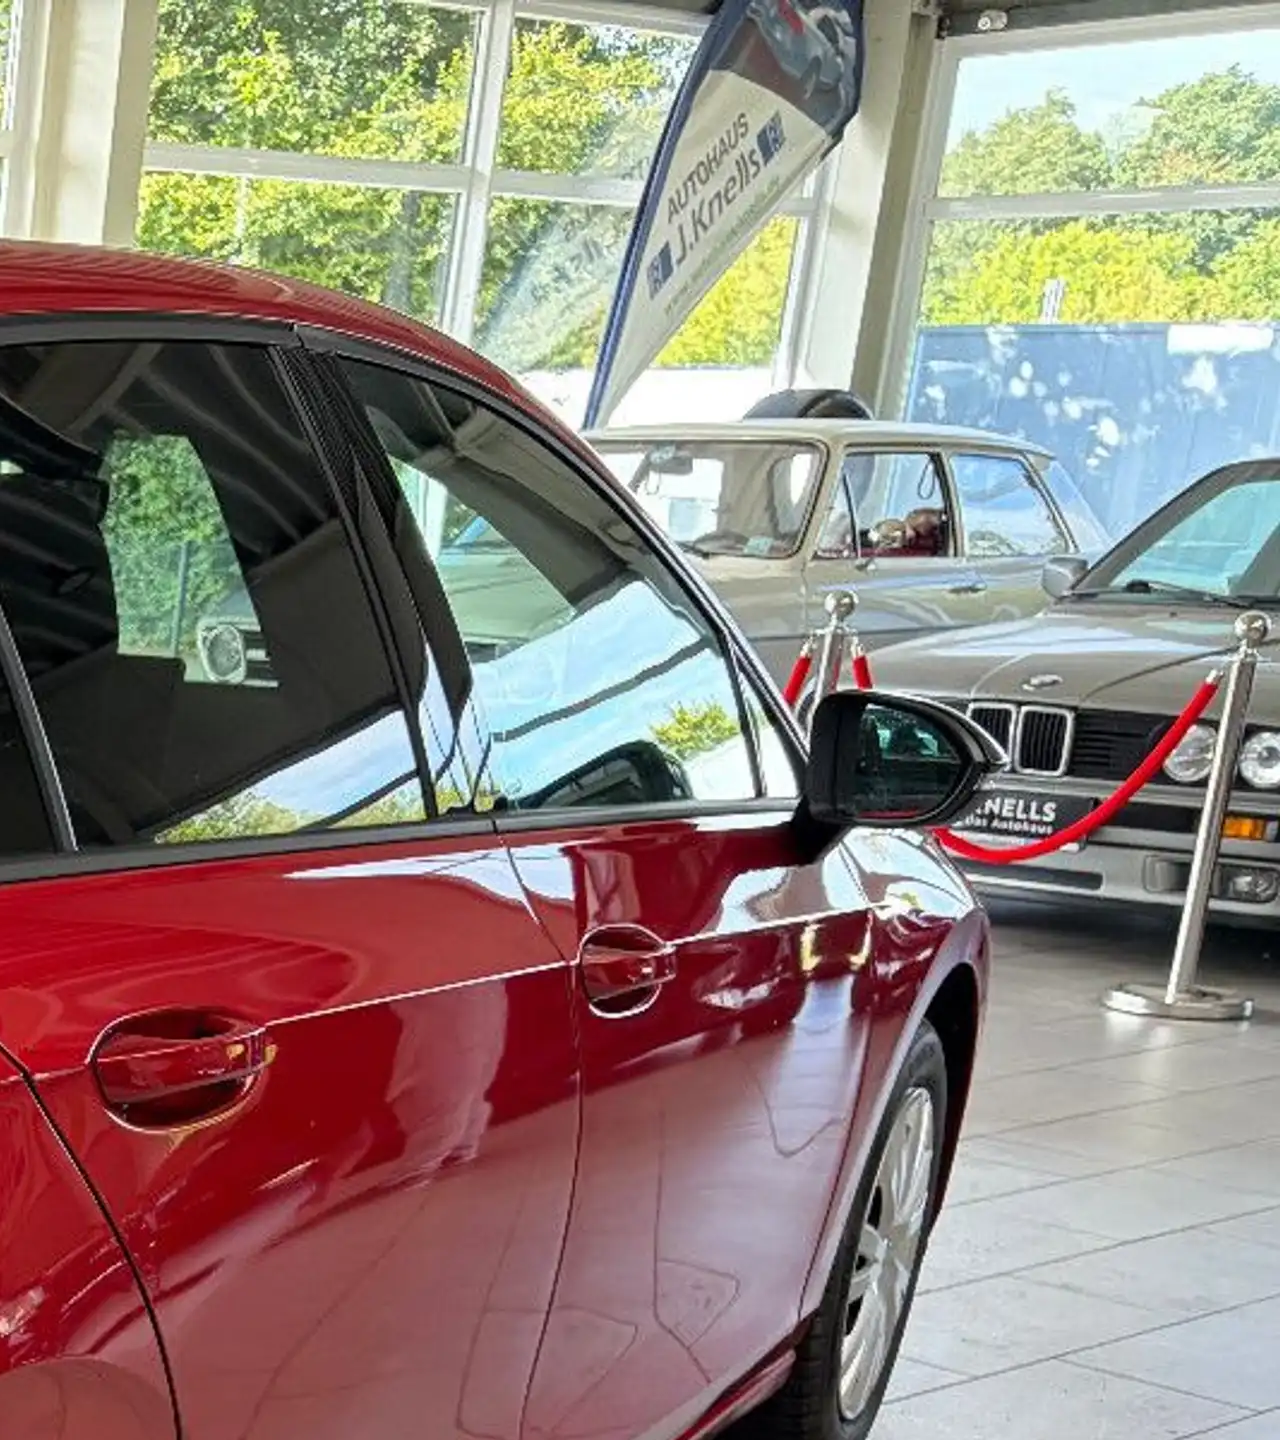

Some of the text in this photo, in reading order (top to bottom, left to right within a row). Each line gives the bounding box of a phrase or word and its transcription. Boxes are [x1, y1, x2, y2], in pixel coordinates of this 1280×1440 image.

[667, 112, 749, 224] AUTOHAUS
[676, 150, 762, 267] J.Knells
[975, 797, 1057, 822] NELLS
